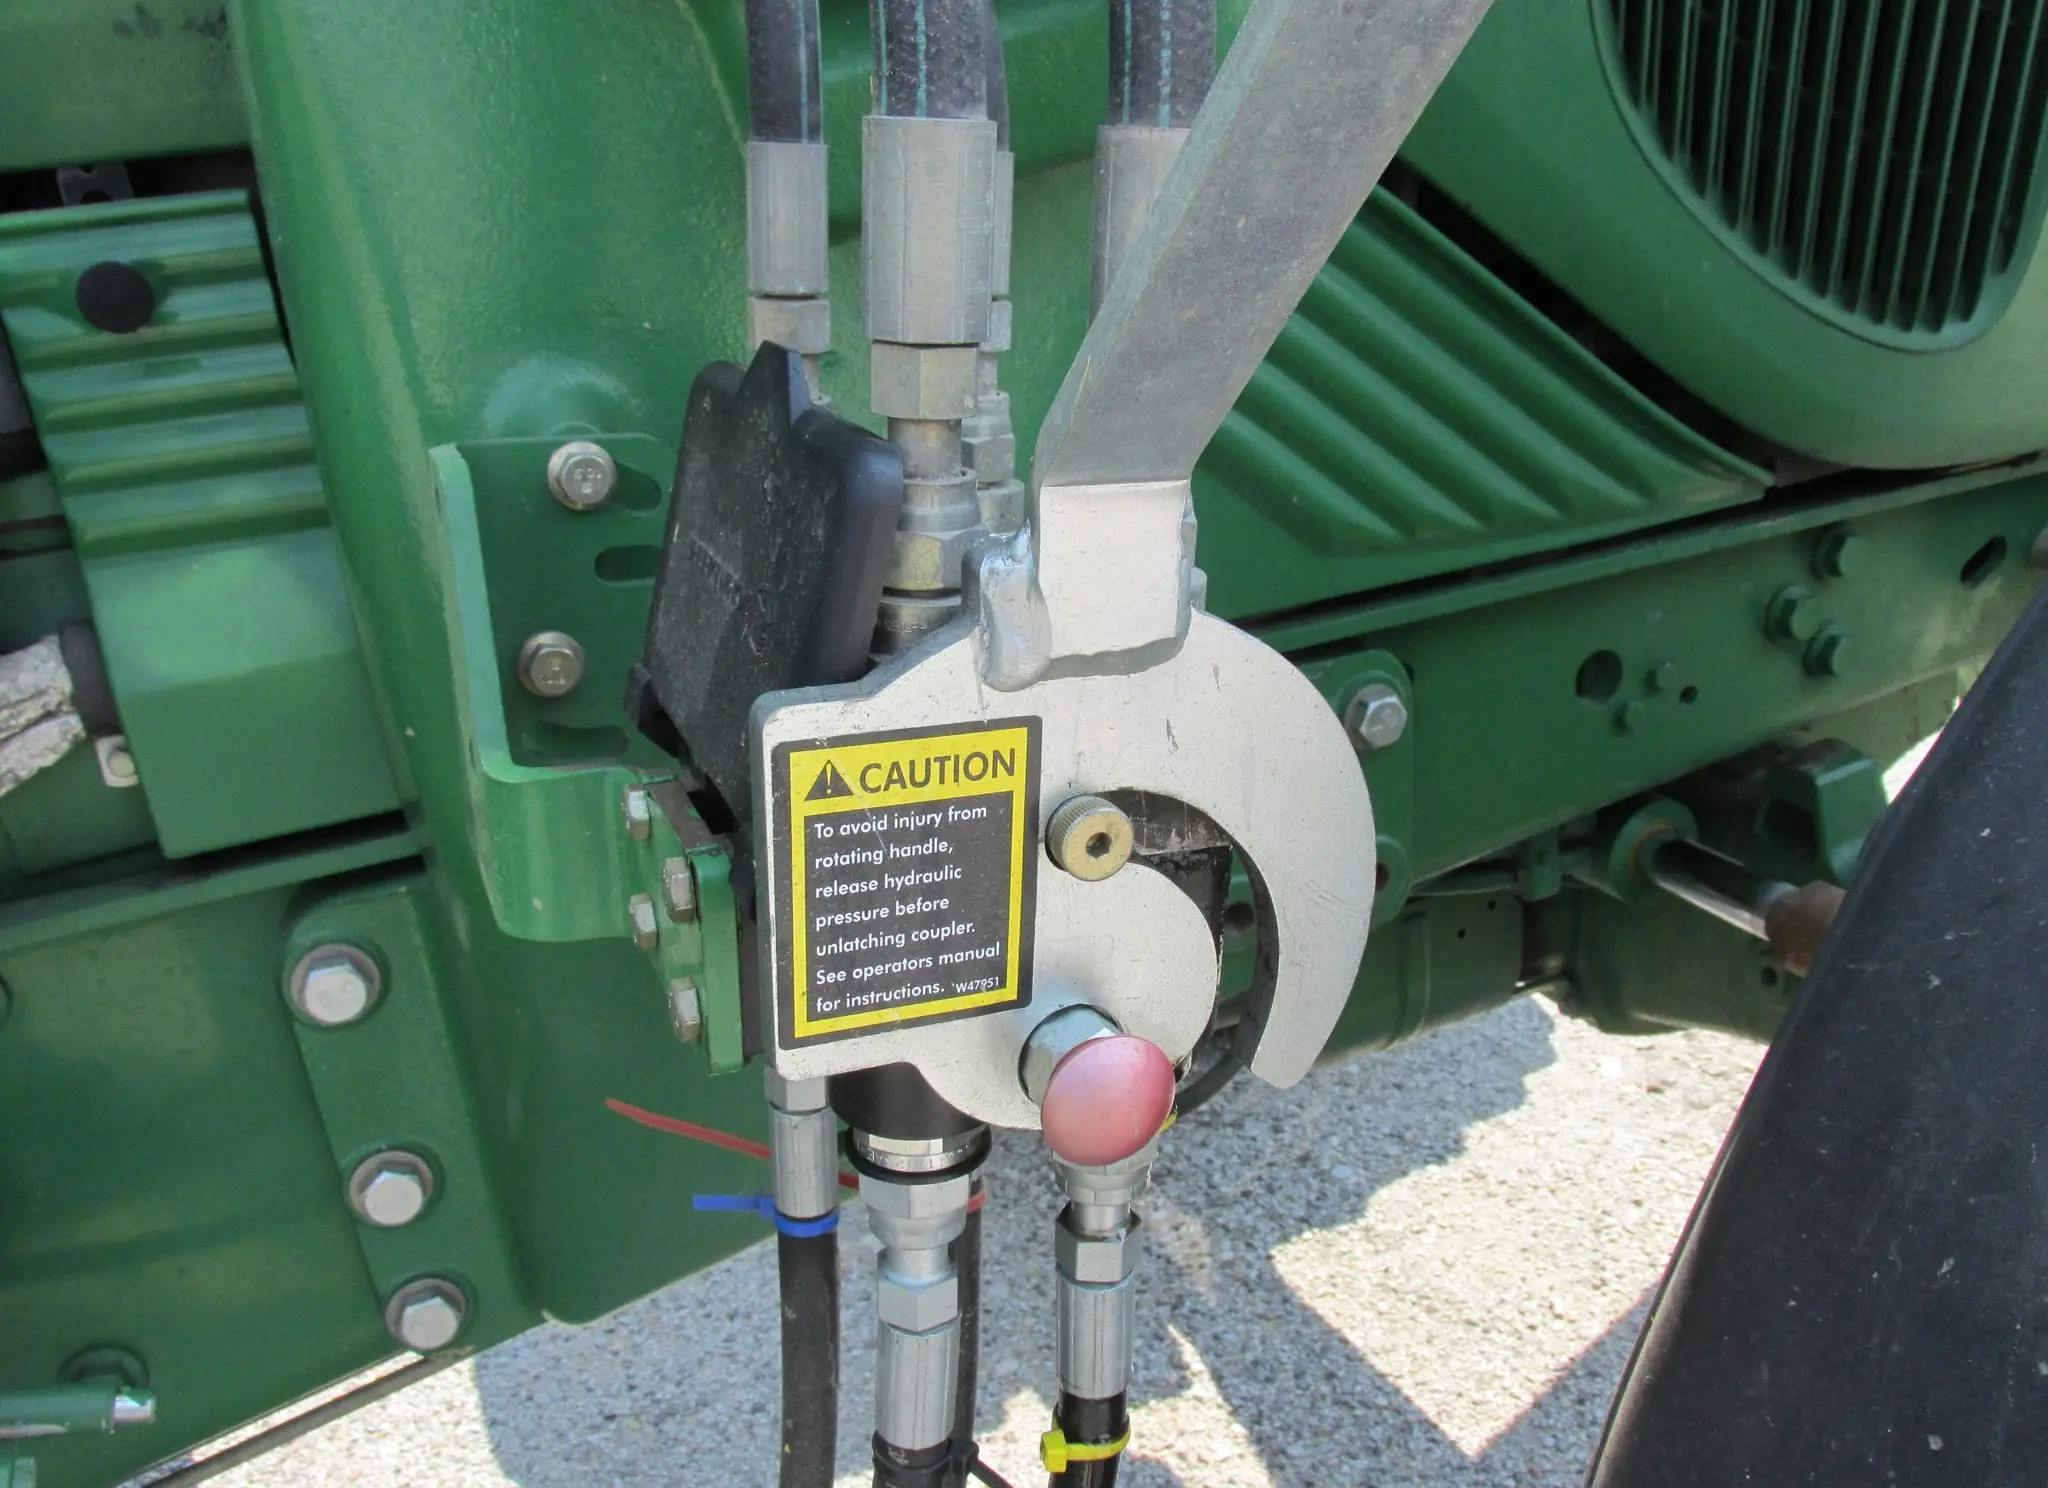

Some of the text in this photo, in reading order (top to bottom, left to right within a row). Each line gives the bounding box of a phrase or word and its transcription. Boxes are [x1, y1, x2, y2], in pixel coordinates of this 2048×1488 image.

[859, 748, 1016, 794] CAUTION
[814, 805, 987, 839] To avoid injury from
[814, 838, 954, 869] rotating handle,
[815, 865, 962, 898] release hydraulic
[815, 898, 949, 932] pressure before
[816, 921, 976, 957] unlatching coupler.
[816, 941, 1000, 984] See operators manual
[816, 982, 945, 1013] for instructions.
[956, 976, 1000, 994] W47951
